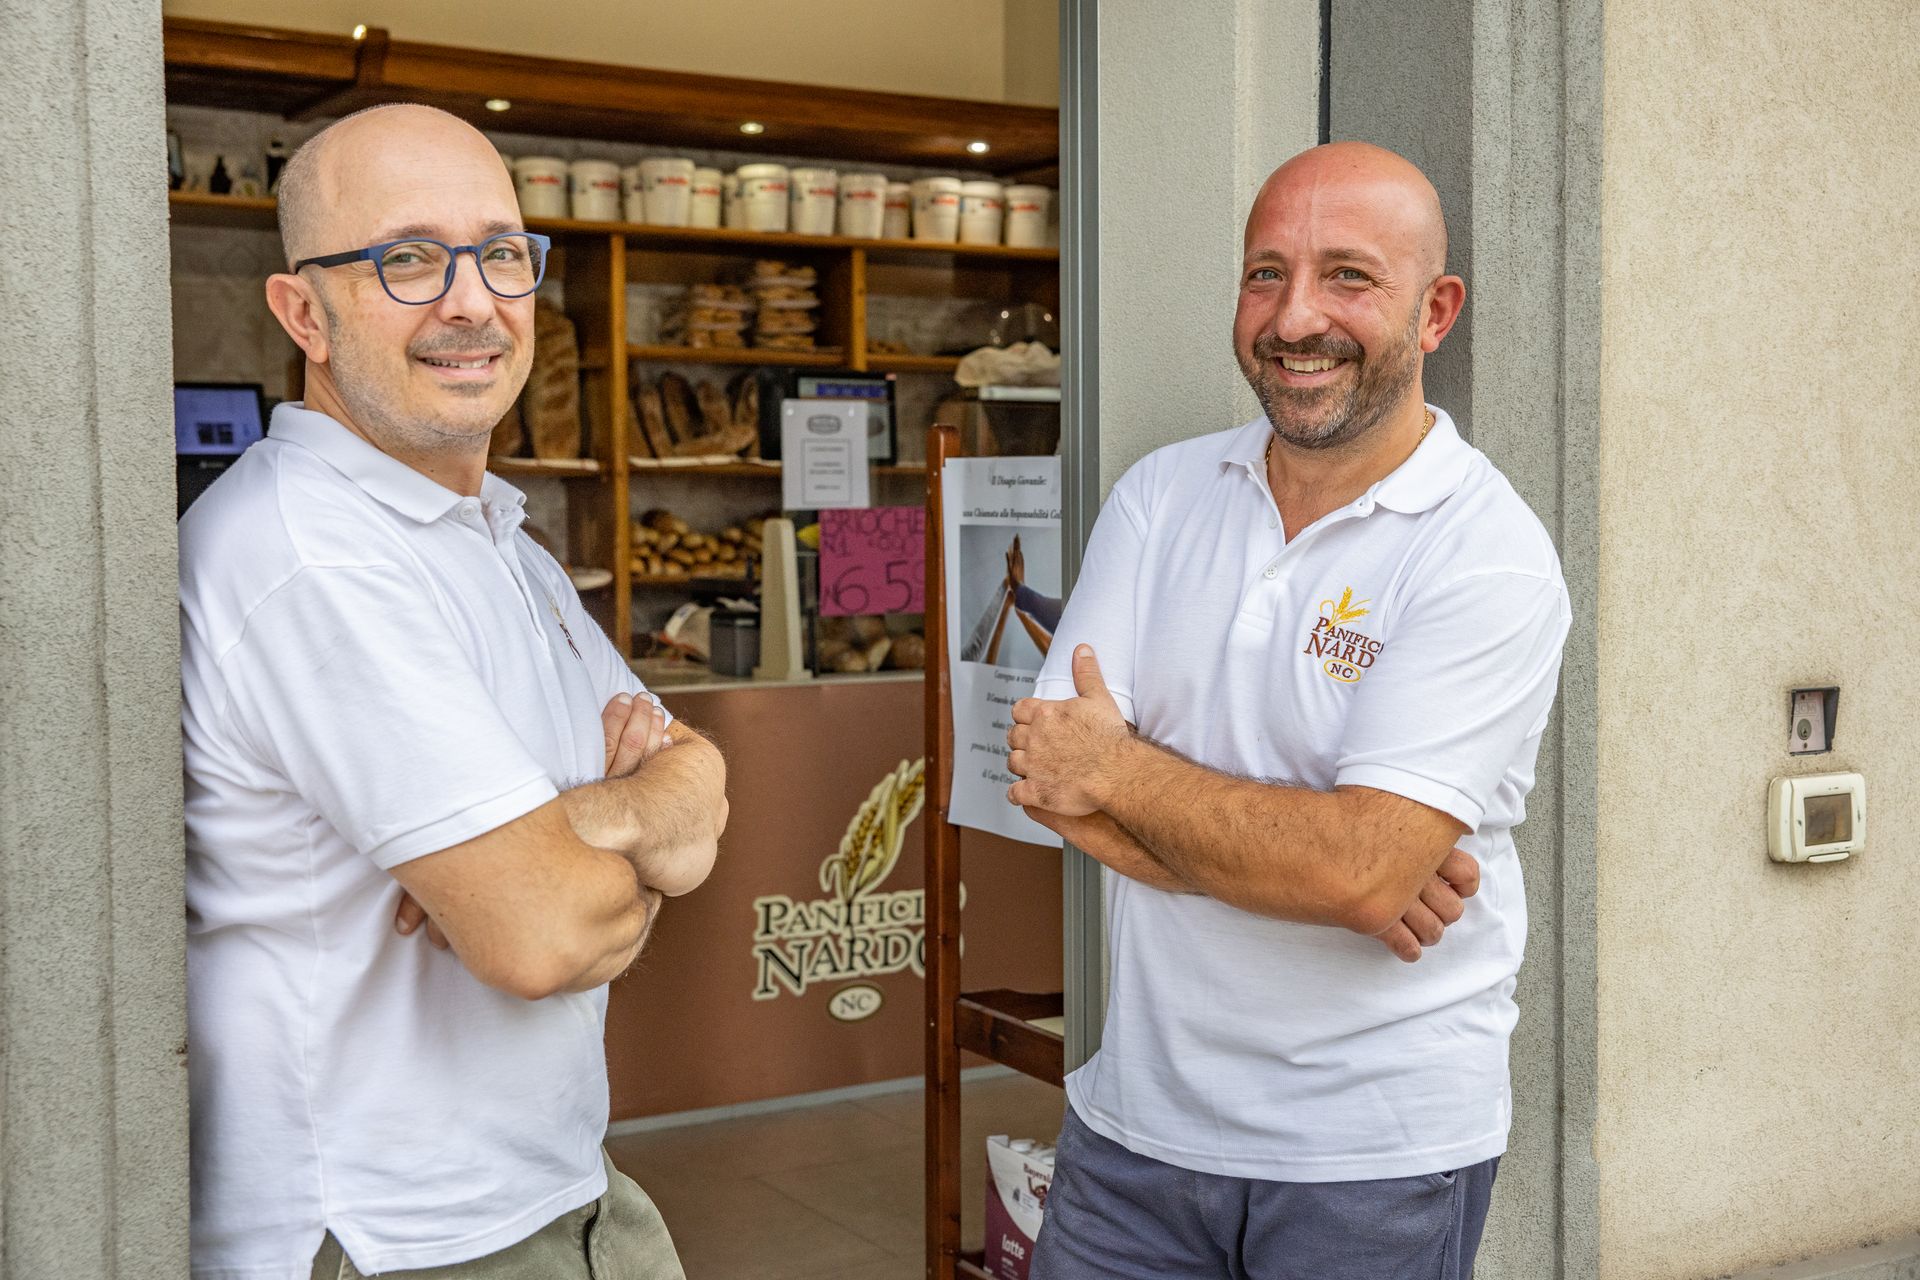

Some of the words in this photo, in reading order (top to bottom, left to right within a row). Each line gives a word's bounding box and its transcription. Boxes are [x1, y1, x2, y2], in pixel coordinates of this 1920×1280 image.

[1303, 632, 1376, 669] NARD
[1330, 663, 1354, 679] NC
[758, 896, 925, 937] PANIFICI
[756, 932, 925, 995] NARD
[838, 993, 873, 1016] NC
